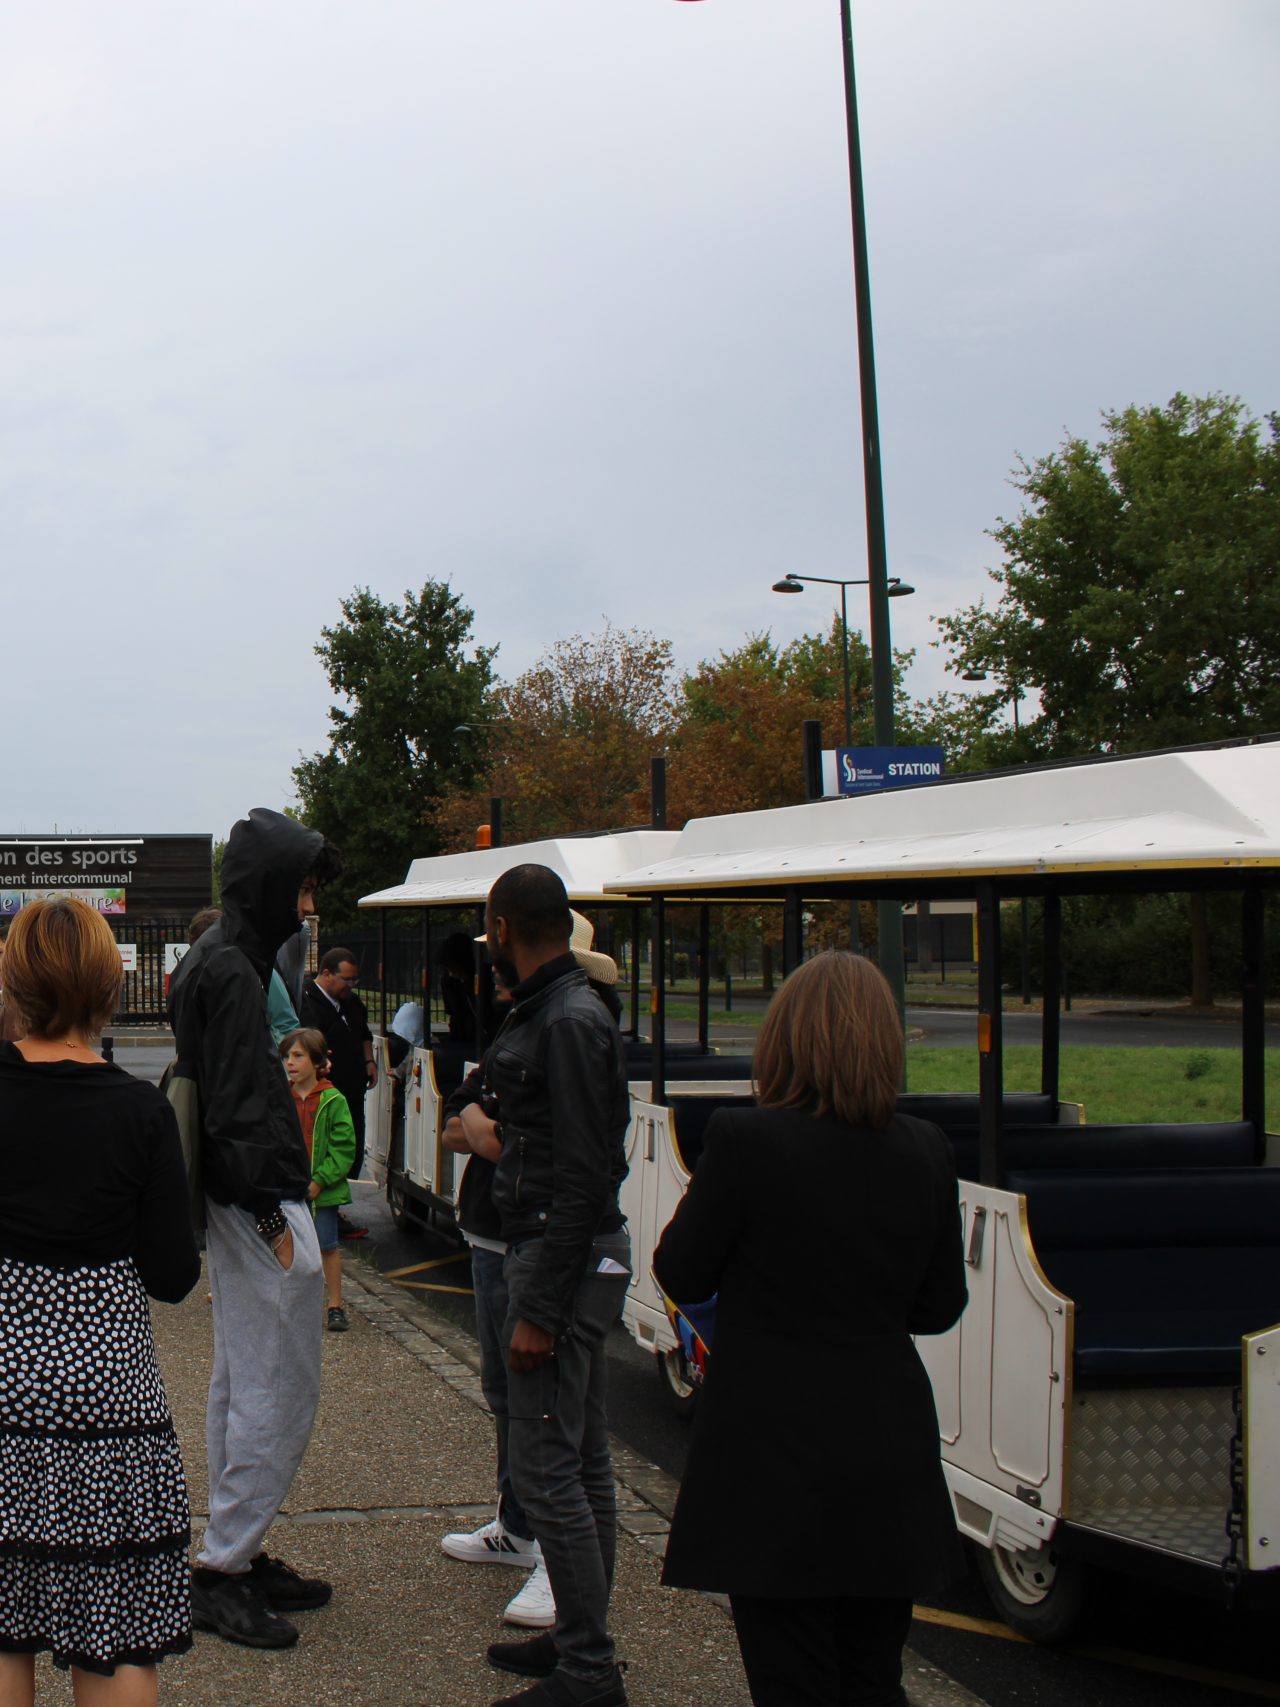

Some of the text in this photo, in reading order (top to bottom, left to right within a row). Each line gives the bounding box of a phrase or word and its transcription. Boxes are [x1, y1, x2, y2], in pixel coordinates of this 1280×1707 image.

[888, 763, 940, 776] STATION
[25, 846, 64, 866] des
[72, 847, 138, 869] sports
[31, 871, 132, 885] intercommunal
